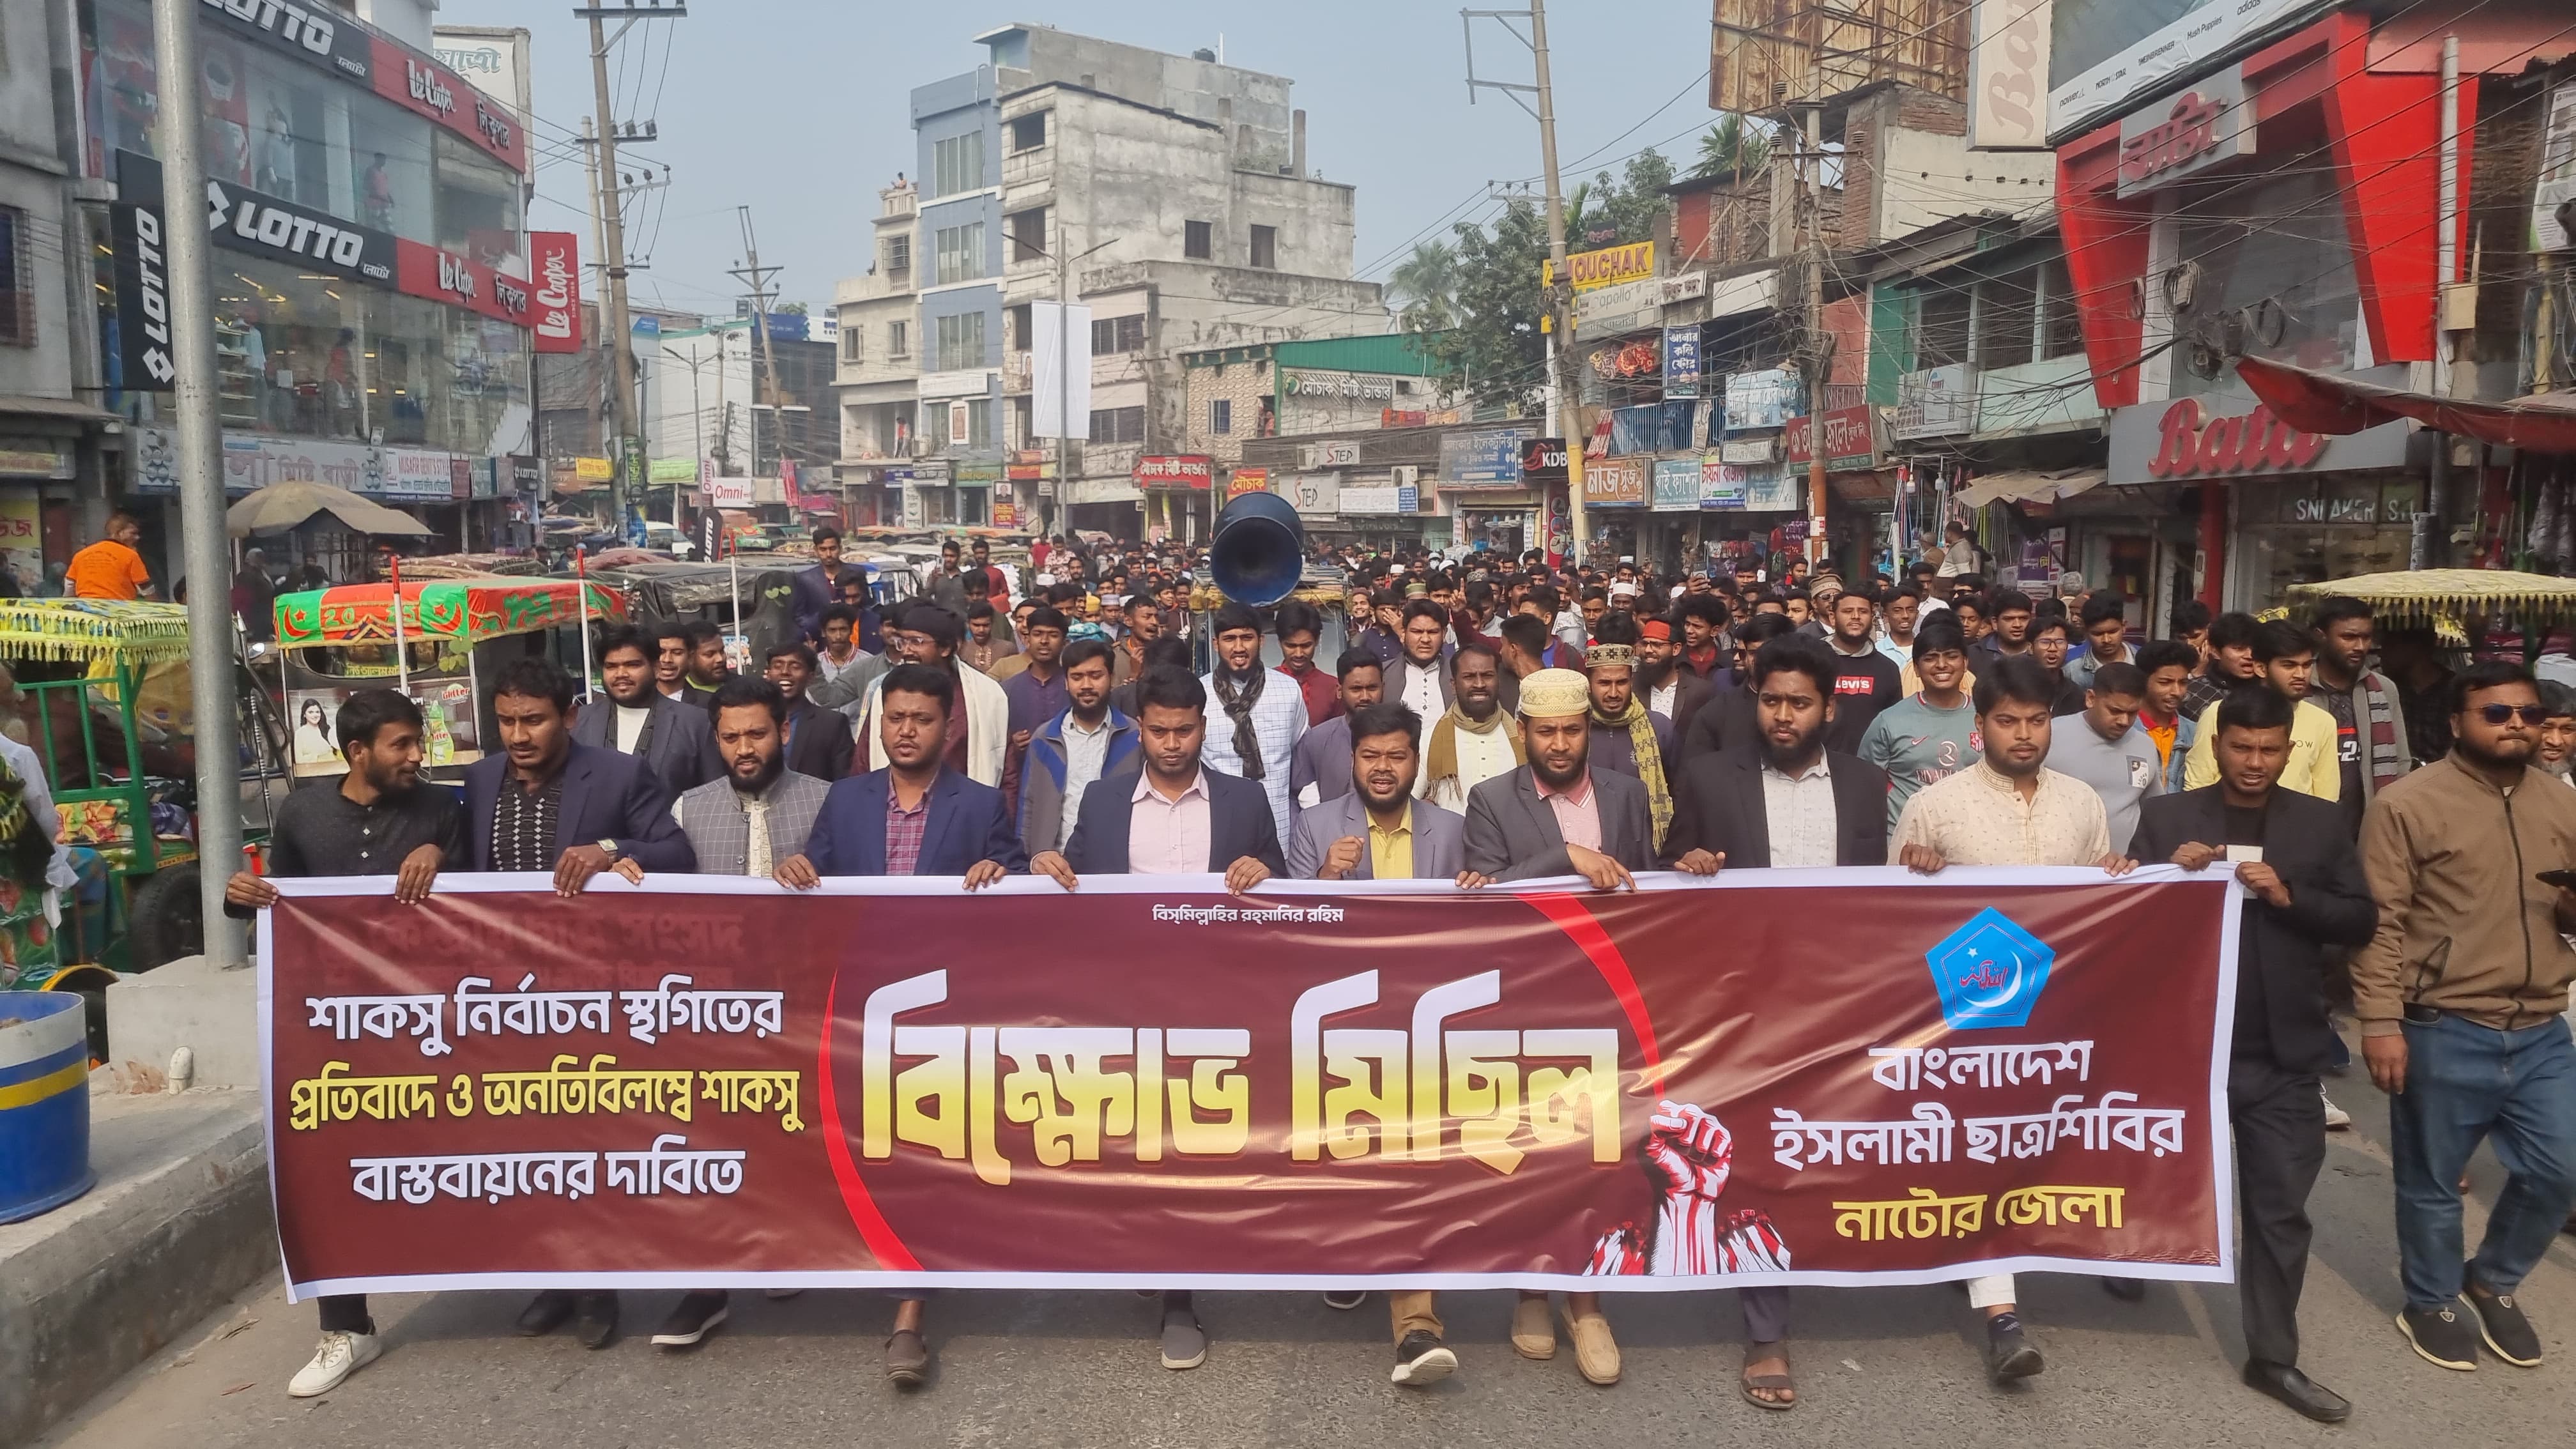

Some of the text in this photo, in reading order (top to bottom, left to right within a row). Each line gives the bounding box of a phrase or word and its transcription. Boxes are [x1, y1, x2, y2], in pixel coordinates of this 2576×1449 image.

[2201, 15, 2223, 34] Puppies
[2237, 0, 2261, 16] adidas
[204, 0, 335, 56] OTTO
[2095, 68, 2127, 91] NORTH STAR
[2058, 91, 2079, 110] power
[2121, 92, 2224, 180] বাটা
[234, 200, 364, 268] LOTTO
[135, 206, 169, 345] LOTTO
[535, 247, 576, 339] Lee Cooper
[1301, 379, 1334, 397] মৌচাক
[1340, 378, 1360, 399] মিষ্টি
[1326, 444, 1353, 463] STEP
[2147, 397, 2326, 479] Bata
[1542, 452, 1568, 468] KDB
[1702, 464, 1721, 486] চায়না
[1723, 465, 1745, 484] বাজার
[715, 484, 744, 500] Omni
[1231, 475, 1266, 492] মৌচাক
[1294, 476, 1318, 509] STEP
[1586, 466, 1622, 501] নাজ
[1671, 471, 1699, 496] ফ্যাশন
[705, 516, 714, 556] LOTTO
[324, 607, 355, 627] 20
[442, 687, 470, 702] Glitter
[433, 732, 448, 741] litter
[1306, 904, 1344, 924] রহিম
[306, 972, 785, 1056] শাকসু নির্বাচন স্থগিতের
[862, 969, 1621, 1185] বিক্ষোভ মিছিল
[1867, 1040, 2094, 1092] বাংলাদেশ
[290, 1054, 805, 1133] প্রতিবাদে ও অনতিবিলম্বে শাকসু
[1770, 1091, 2185, 1171] ইসলামী ছাত্রশিবির
[349, 1133, 746, 1205] বাস্তবায়নের দাবিতে
[1832, 1184, 2125, 1243] নাটোর জেলা
